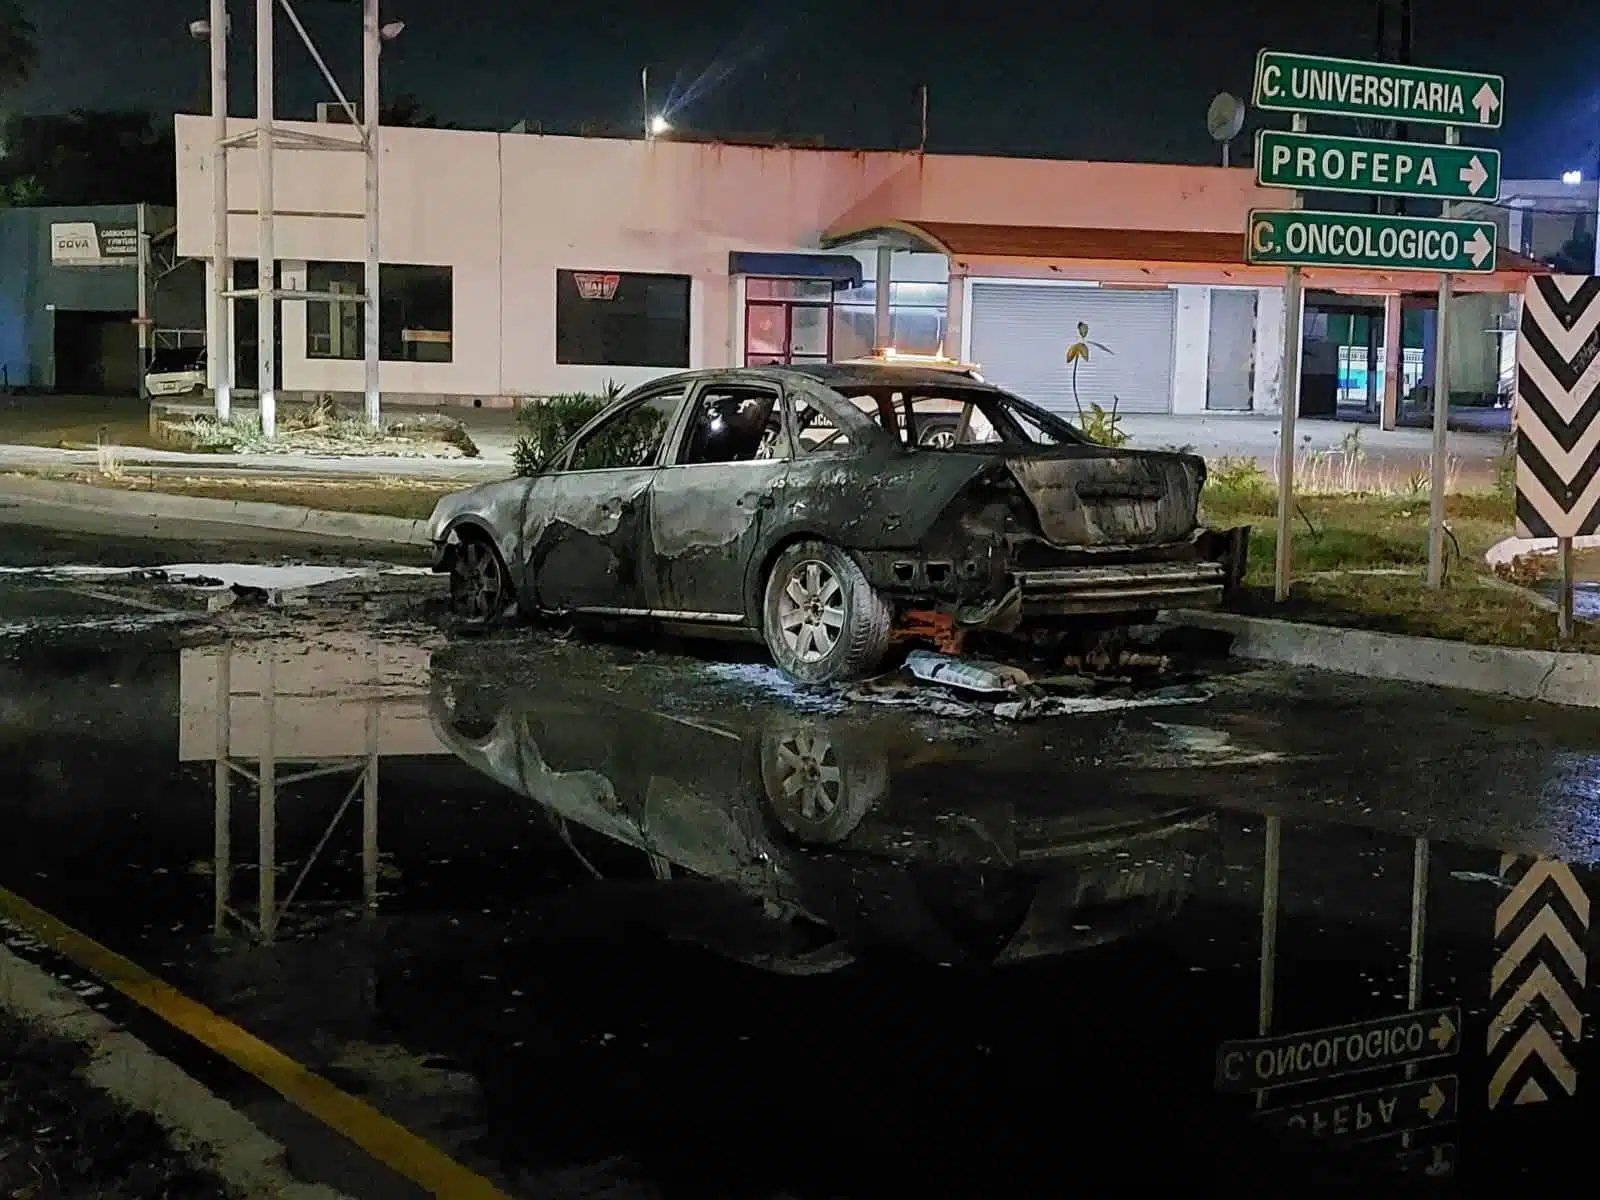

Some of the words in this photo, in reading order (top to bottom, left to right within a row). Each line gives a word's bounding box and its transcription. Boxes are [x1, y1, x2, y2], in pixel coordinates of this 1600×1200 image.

[1262, 65, 1286, 97] C.
[1291, 69, 1465, 115] UNIVERSITARIA
[1272, 145, 1438, 187] PROFEPA
[1252, 220, 1282, 254] C.
[1286, 222, 1459, 261] ONCOLOGICO
